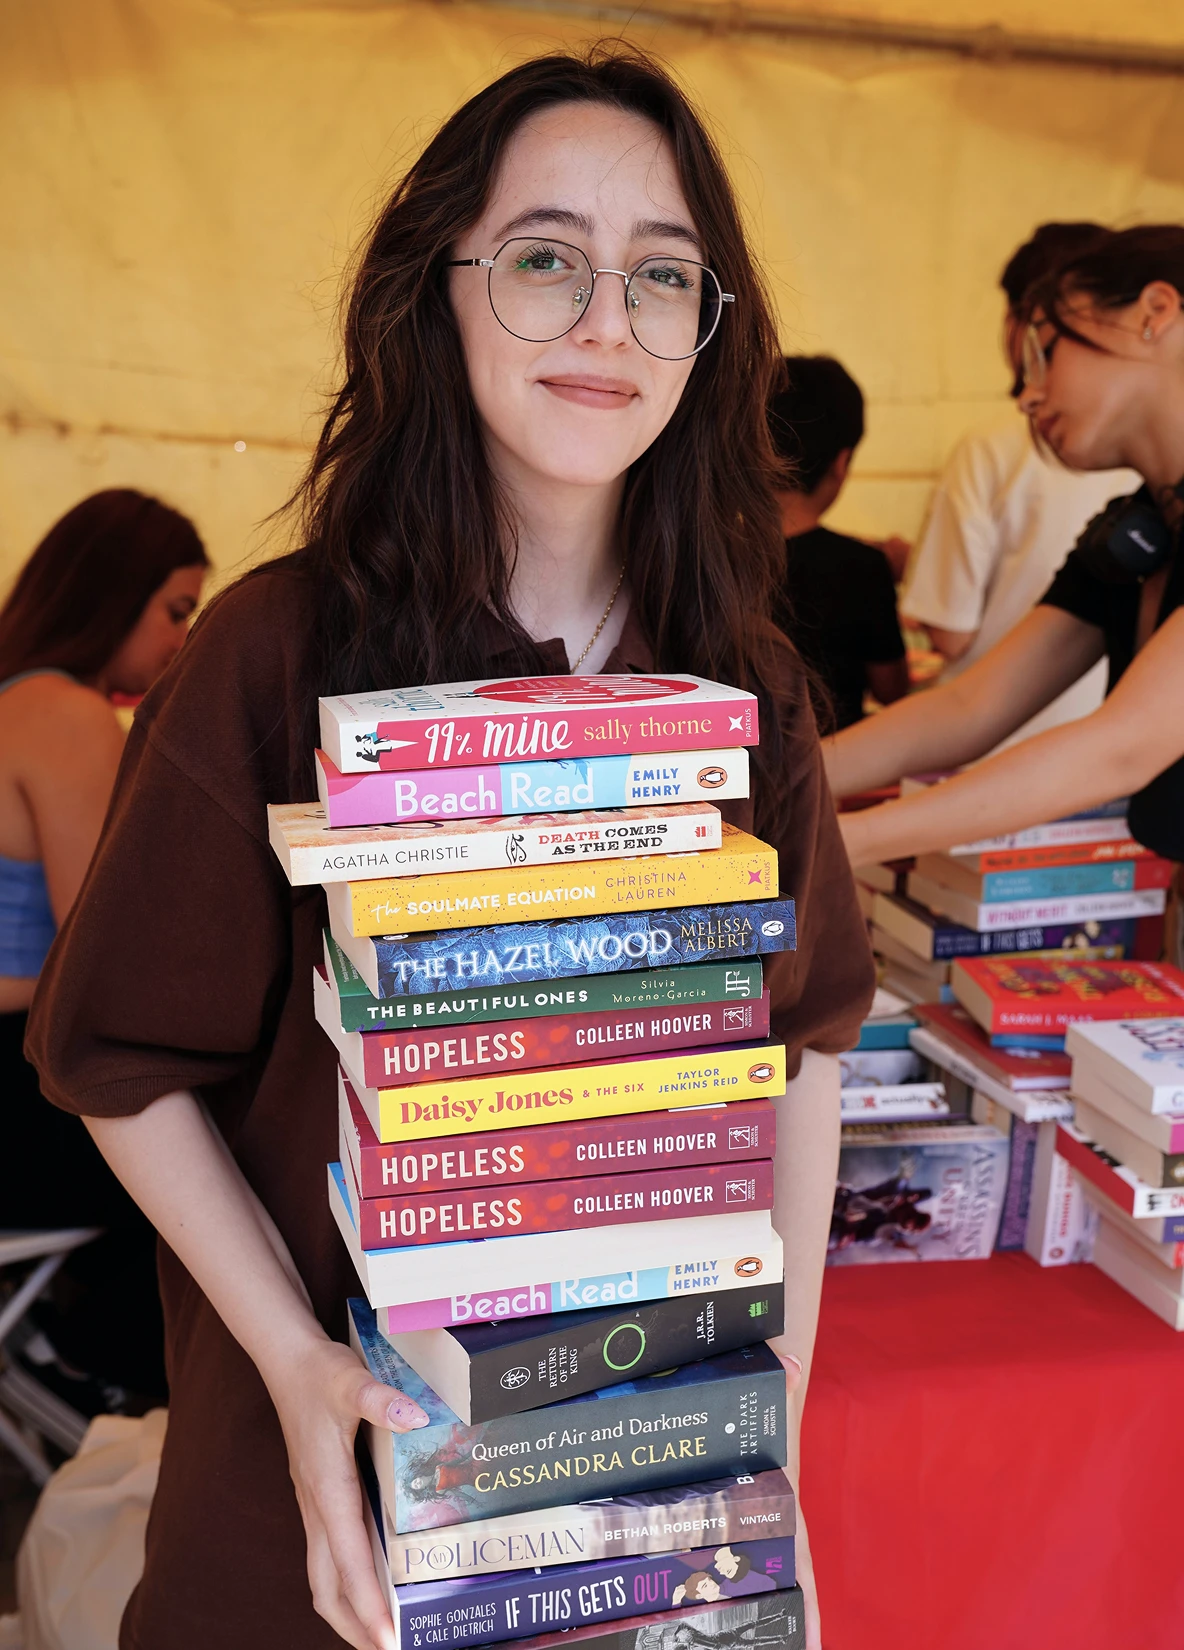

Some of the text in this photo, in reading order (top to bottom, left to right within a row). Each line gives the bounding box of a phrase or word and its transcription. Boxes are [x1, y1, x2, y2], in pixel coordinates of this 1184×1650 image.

[424, 716, 712, 763] 99% mine sally thorne
[633, 768, 679, 782] EMILY
[394, 768, 594, 817] Beach Read
[631, 784, 681, 798] HENRY
[538, 824, 668, 845] DEATH COMES
[552, 837, 663, 856] AS THE END
[322, 846, 469, 870] AGATHA CHRISTIE
[605, 872, 687, 888] CHRISTINA
[371, 885, 596, 923] the SOULMATE EQUATION
[617, 888, 676, 902] LAUREN
[681, 917, 753, 939] MELISSA
[394, 958, 447, 982] THE
[455, 943, 561, 978] HAZEL
[565, 929, 674, 964] WOOD
[684, 932, 748, 953] ALBERT
[612, 988, 706, 1004] Moreno-Garcia
[641, 979, 675, 990] Silvia
[367, 990, 589, 1019] THE BEAUTIFUL ONES
[1000, 1012, 1043, 1026] SARAH
[383, 1014, 712, 1076] HOPELESS COLLEEN HOOVER
[658, 1076, 739, 1093] JENKINS REID
[677, 1068, 720, 1080] TAYLOR
[400, 1083, 645, 1124] Daisy Jones & THE SIX
[381, 1132, 717, 1185] HOPELESS COLLEEN HOOVER
[380, 1186, 714, 1239] HOPELESS COLLEEN HOOVER
[674, 1260, 718, 1275] EMILY
[450, 1271, 638, 1322] Beach Read
[673, 1275, 719, 1290] HENRY
[697, 1310, 706, 1340] J.R.R.
[706, 1301, 715, 1344] TOLKIEN
[538, 1359, 547, 1382] THE
[549, 1347, 557, 1388] RETURN
[559, 1345, 567, 1383] OF THE
[570, 1348, 578, 1374] KING
[471, 1411, 708, 1462] Queen of Air and Darkness
[740, 1394, 748, 1456] THE DARK
[750, 1391, 758, 1455] ARTIFICES
[474, 1436, 707, 1493] CASSANDRA CLARE
[604, 1517, 727, 1541] BETHAN ROBERTS
[739, 1513, 781, 1525] VINTAGE
[405, 1527, 585, 1575] POLICEMAN
[433, 1551, 448, 1564] MY
[505, 1569, 673, 1629] IF THIS GETS OUT
[410, 1602, 497, 1631] SOPHIE GONZALES
[413, 1619, 494, 1647] & CALE DIETRICH
